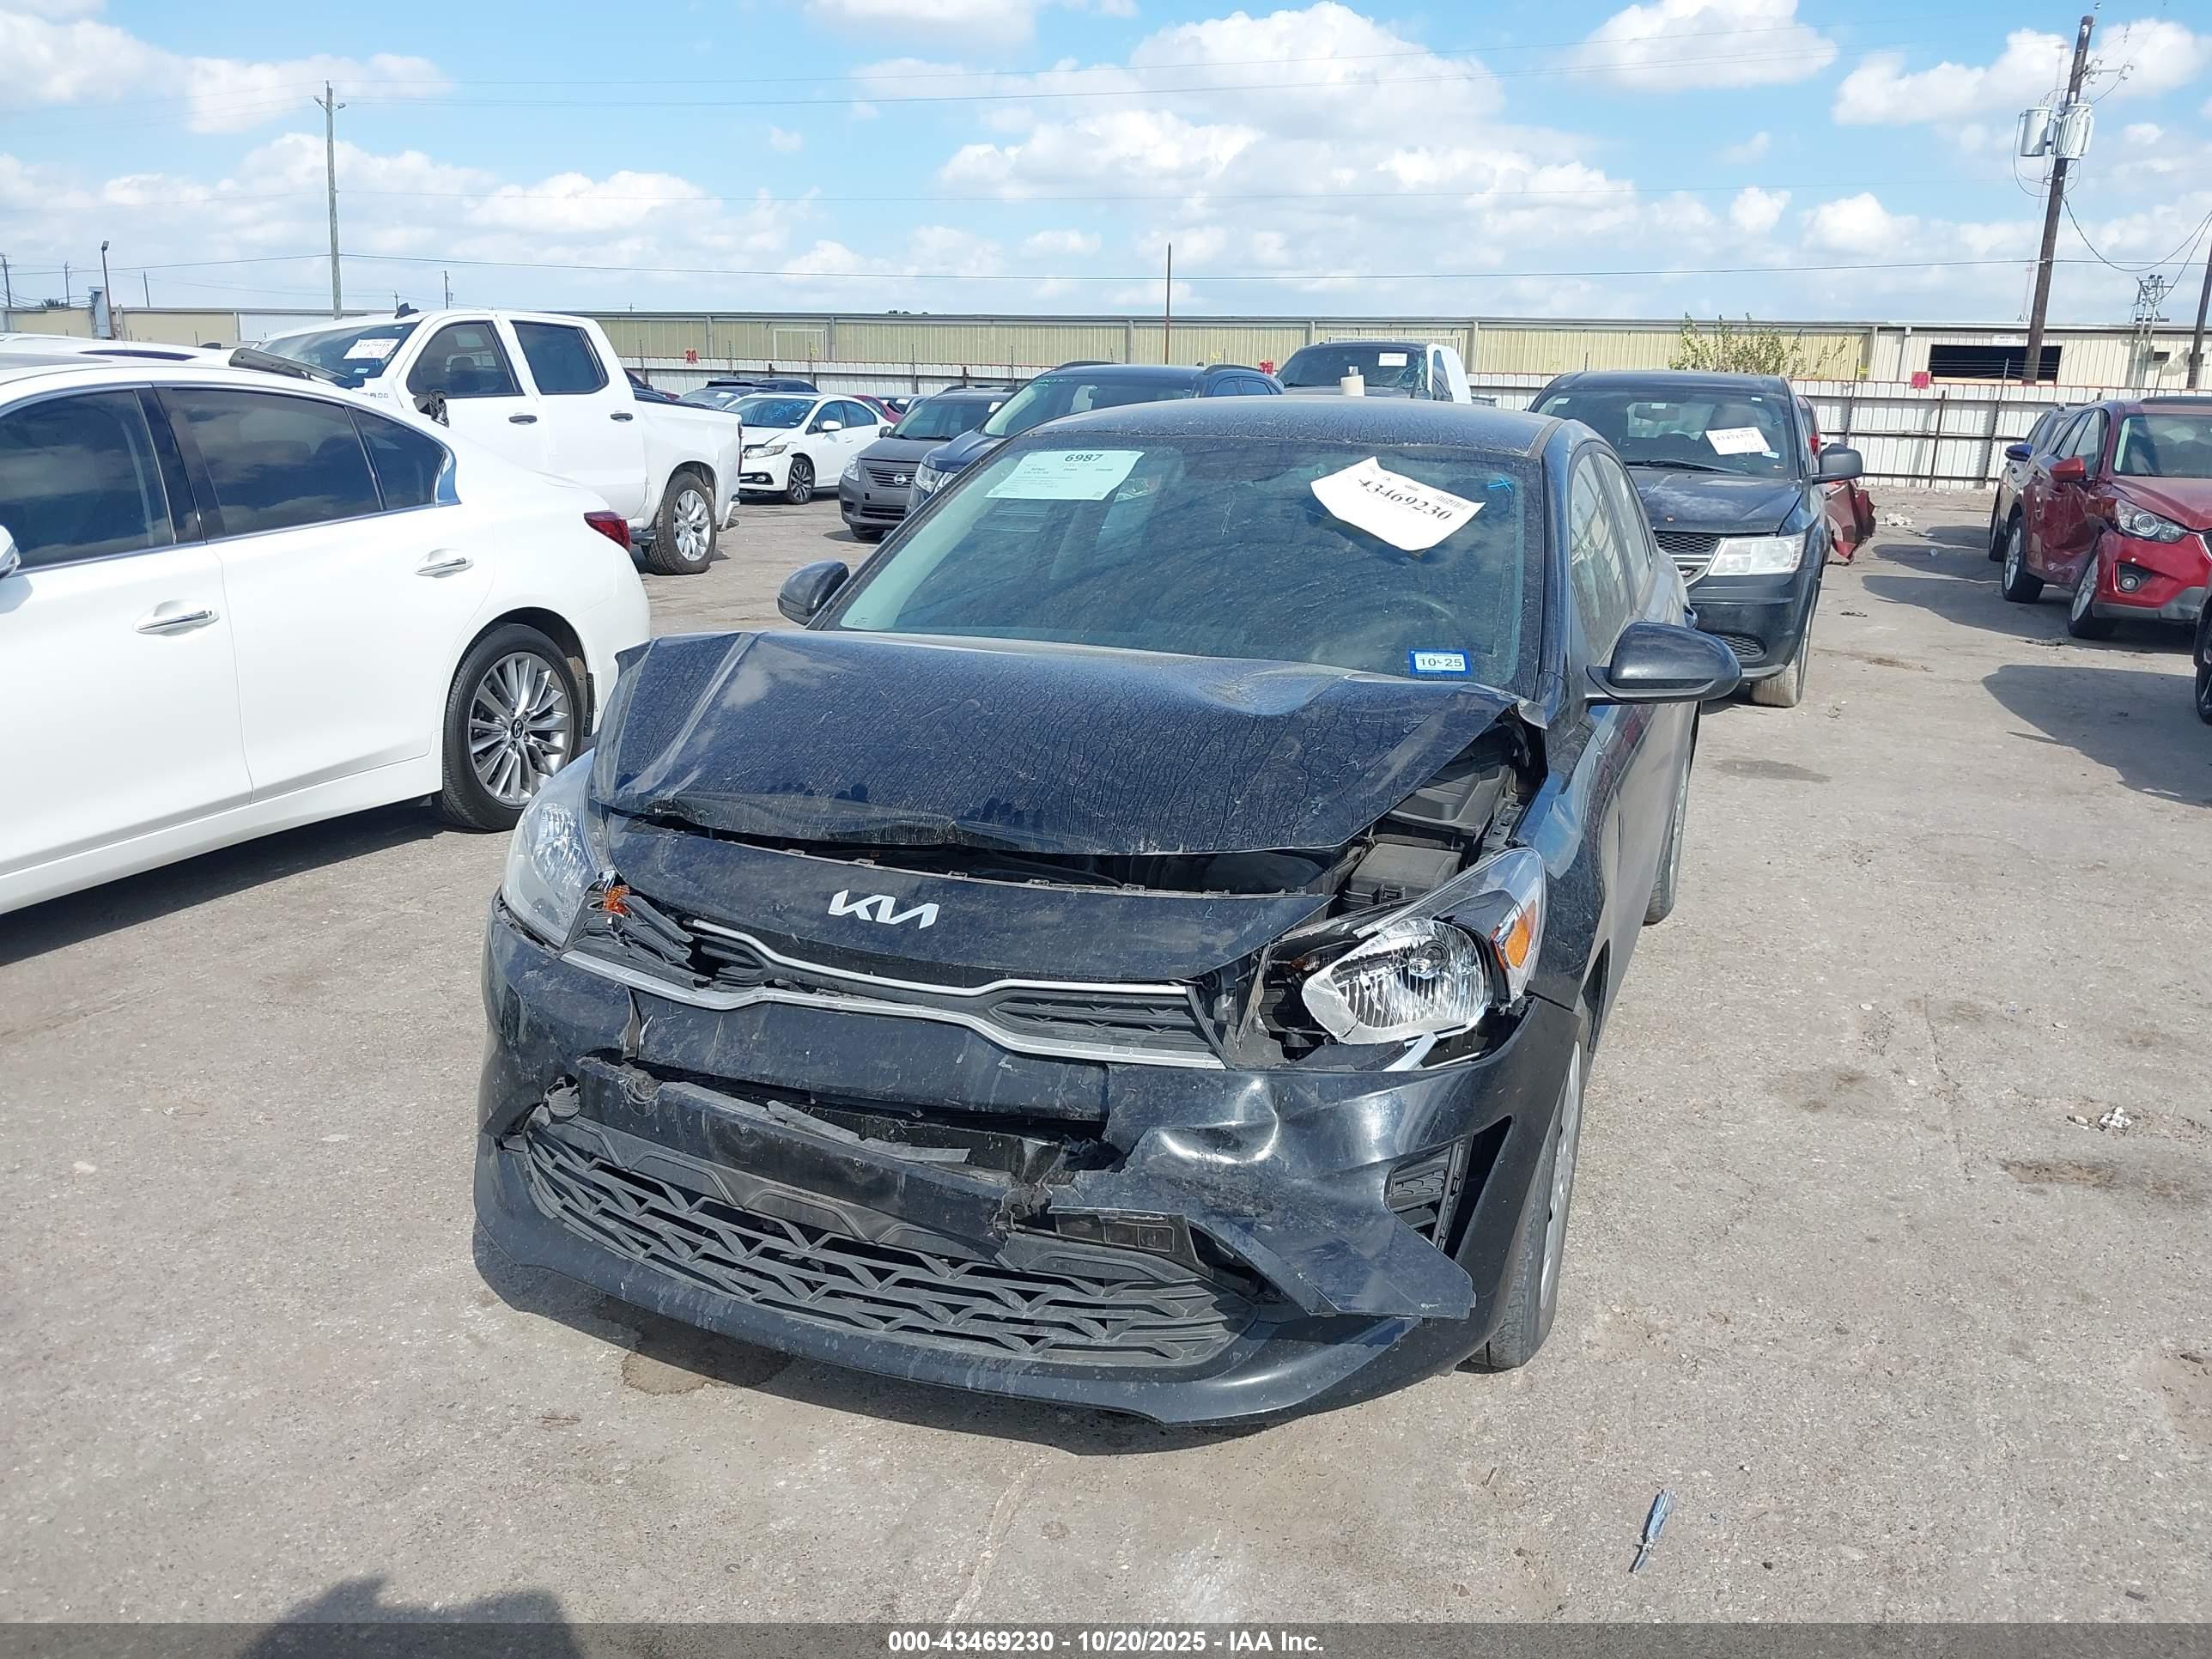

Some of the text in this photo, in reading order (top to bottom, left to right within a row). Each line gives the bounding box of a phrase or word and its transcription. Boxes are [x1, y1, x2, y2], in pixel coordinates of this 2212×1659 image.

[1065, 453, 1103, 462] 6987
[1358, 478, 1454, 520] 43469230
[828, 889, 939, 929] KIA
